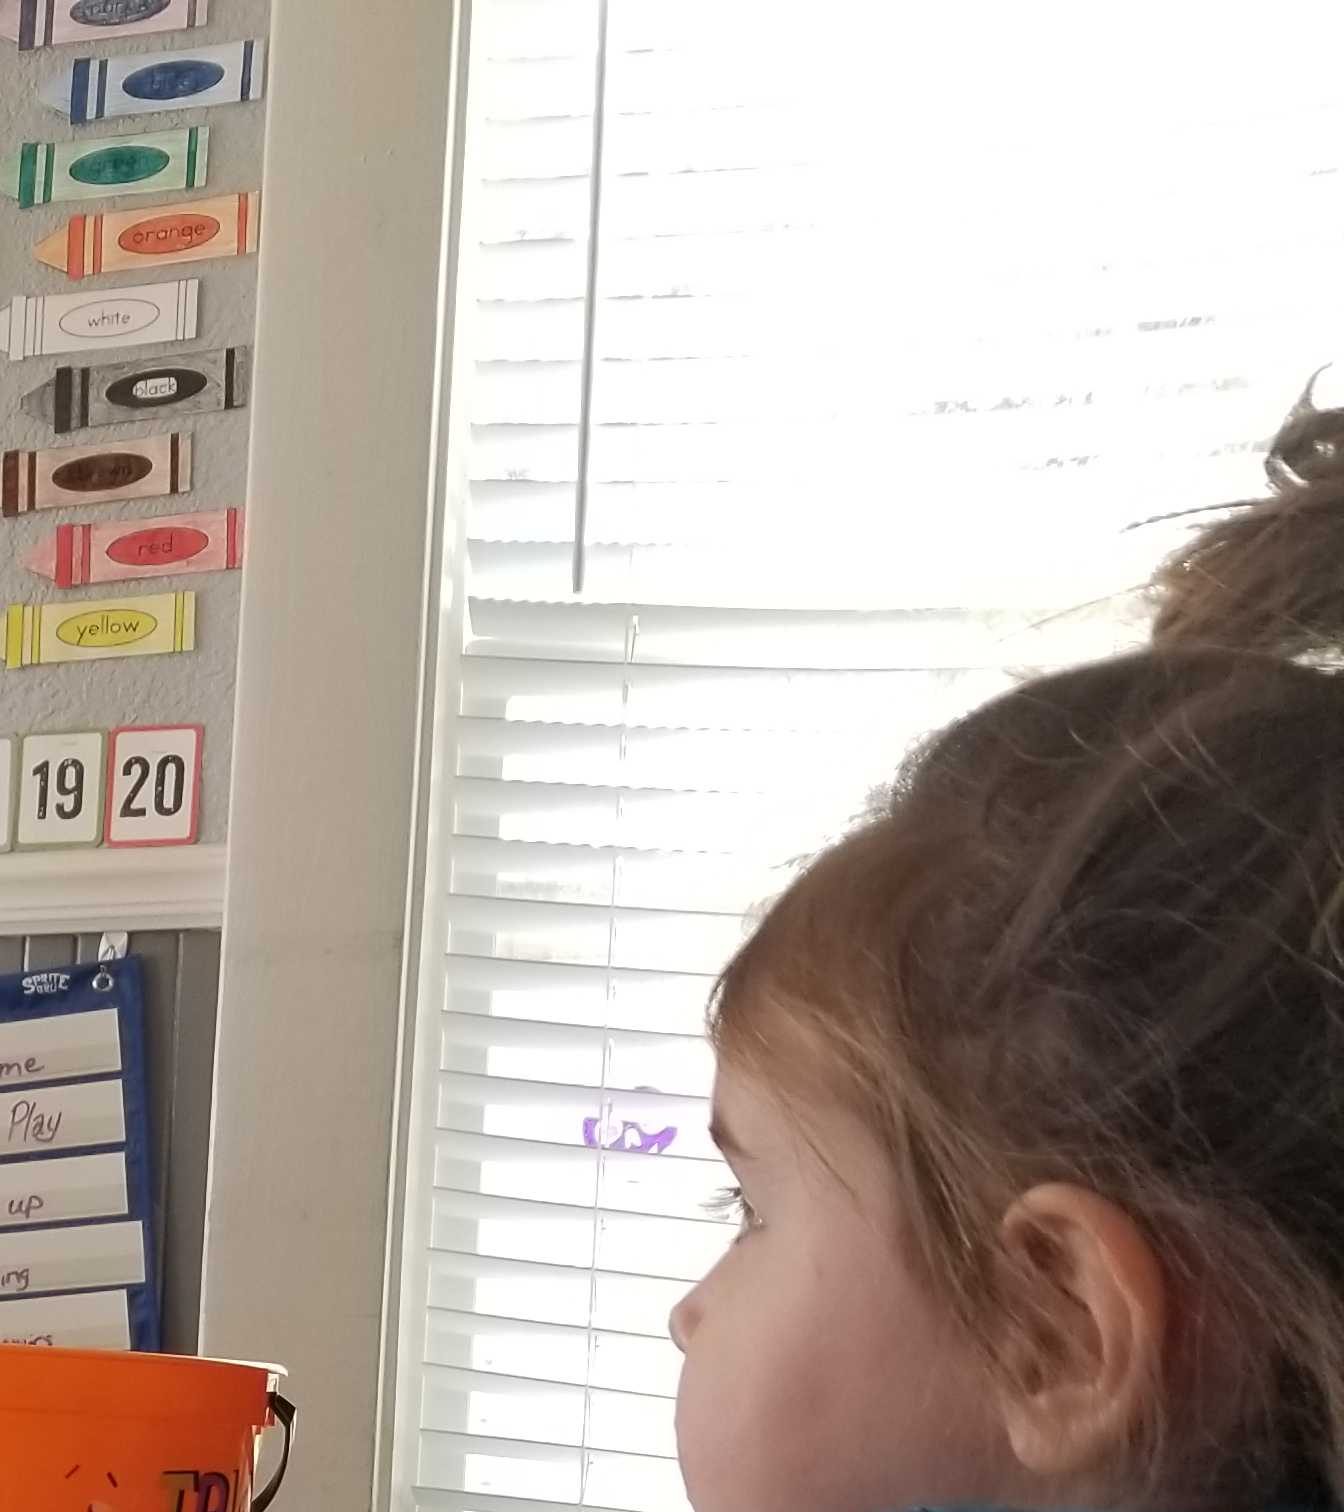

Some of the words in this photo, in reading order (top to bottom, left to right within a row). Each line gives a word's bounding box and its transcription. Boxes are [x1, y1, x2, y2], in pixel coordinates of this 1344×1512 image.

[132, 223, 207, 244] orange
[88, 309, 131, 328] white
[134, 374, 176, 396] black
[138, 533, 174, 556] red
[77, 614, 140, 646] yellow
[32, 758, 85, 820] 19
[119, 754, 186, 818] 20
[8, 1100, 62, 1144] Play
[8, 1195, 43, 1220] up
